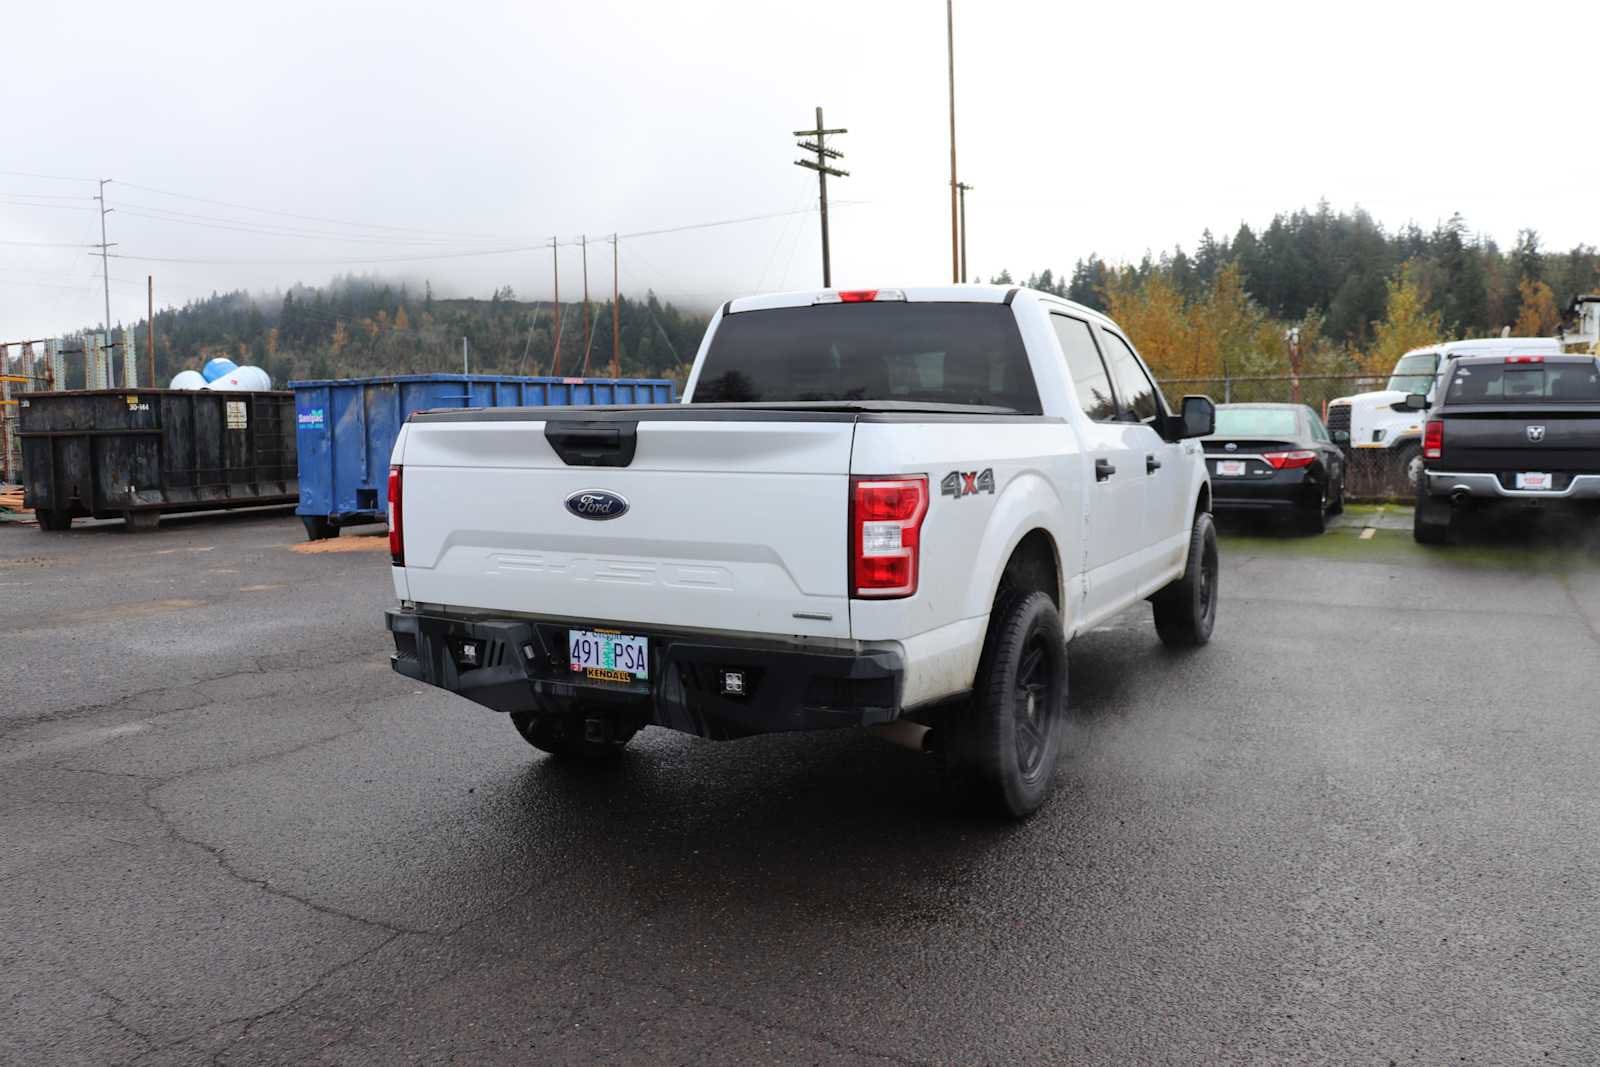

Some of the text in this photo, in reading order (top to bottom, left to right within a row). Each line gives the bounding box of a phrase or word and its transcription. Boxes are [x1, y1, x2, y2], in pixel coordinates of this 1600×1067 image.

[577, 494, 613, 513] Ford
[572, 638, 645, 670] 491 PSA
[588, 669, 629, 680] KENDALL
